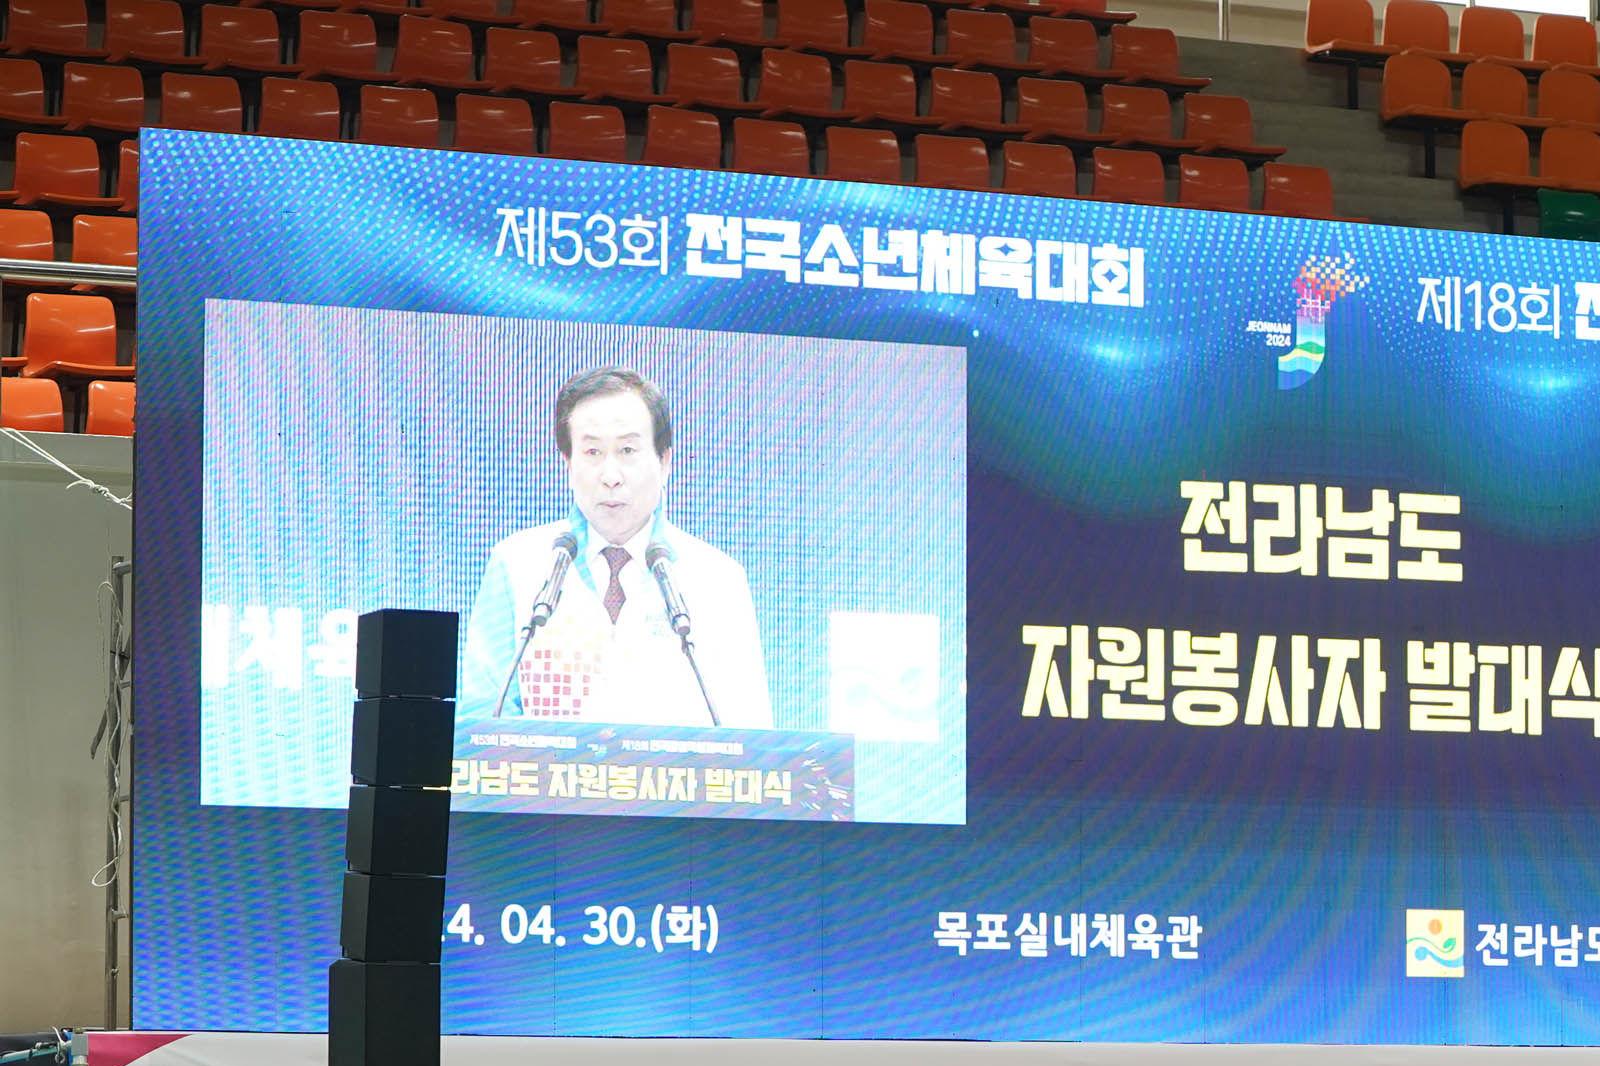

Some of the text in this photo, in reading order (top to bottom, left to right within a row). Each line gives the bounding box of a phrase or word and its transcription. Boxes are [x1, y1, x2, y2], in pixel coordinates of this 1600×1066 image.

[495, 206, 1145, 308] 제53회 전국소년체육대회
[1247, 321, 1291, 334] JEONNAM
[1417, 277, 1560, 341] 제18회
[1266, 334, 1291, 347] 2024
[1181, 479, 1464, 583] 전라남도
[1020, 624, 1385, 732] 자원봉사자
[548, 762, 698, 801] 자원봉사자
[705, 768, 792, 806] 발대식
[441, 904, 720, 954] 4. 04. 30.(화)
[933, 910, 1203, 959] 목포실내체육관
